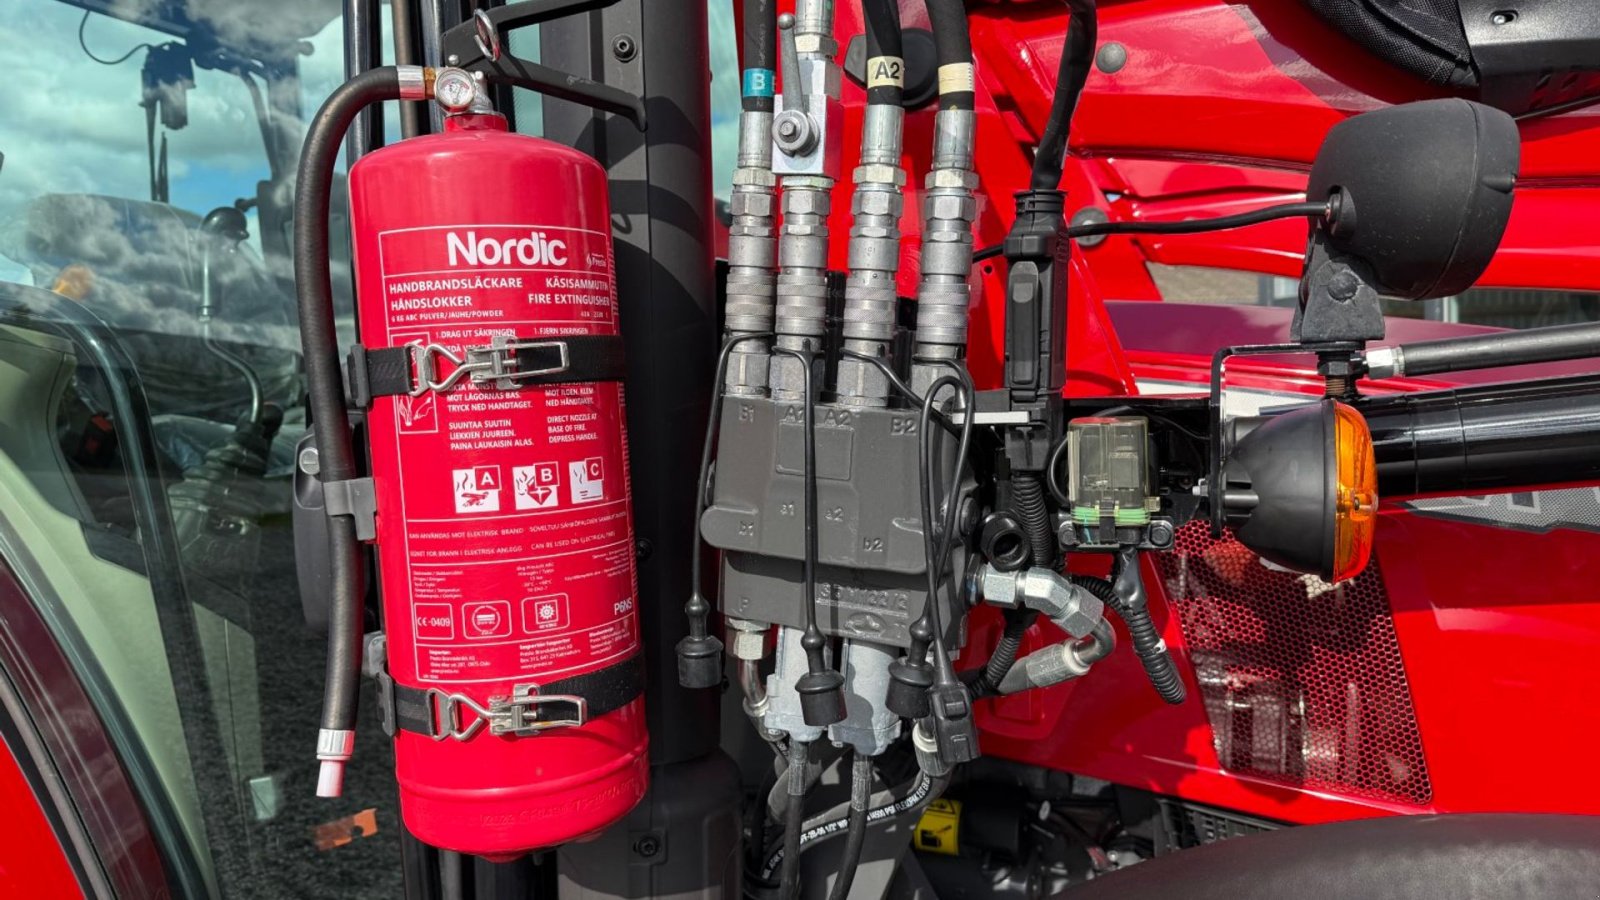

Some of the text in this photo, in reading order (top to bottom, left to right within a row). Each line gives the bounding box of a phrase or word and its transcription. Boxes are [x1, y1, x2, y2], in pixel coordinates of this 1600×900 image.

[874, 61, 900, 80] A2
[446, 231, 568, 266] Nordic
[389, 276, 523, 295] HANDBRANDSLÄCKARE
[391, 295, 472, 311] HÅNDSLOKKER
[528, 293, 610, 306] FIRE EXTINGUISHER
[406, 314, 417, 322] ABC
[463, 329, 472, 338] UT
[474, 328, 516, 337] SÄKRINGEN
[447, 394, 464, 402] MOT
[505, 391, 521, 399] BAS.
[447, 404, 470, 413] TRYCK
[470, 403, 487, 411] NED
[545, 399, 560, 407] NED
[547, 414, 569, 423] DIRECT
[824, 408, 851, 427] A2
[448, 419, 512, 430] SUUNTAA SUUTIN
[548, 425, 564, 434] BASE
[564, 424, 573, 432] OF
[890, 416, 917, 437] B2
[449, 431, 481, 440] LIEKKIEN
[548, 434, 575, 444] DEPRESS
[450, 441, 473, 451] PAINA
[474, 440, 512, 449] LAUKAISIN
[541, 464, 553, 481] B
[589, 462, 600, 477] C
[480, 472, 495, 486] A
[451, 531, 466, 539] MOT
[466, 530, 499, 538] ELEKTRISK
[501, 527, 524, 536] BRAND
[531, 541, 545, 550] CAN
[546, 540, 554, 548] BE
[554, 538, 570, 548] USED
[570, 537, 580, 545] ON
